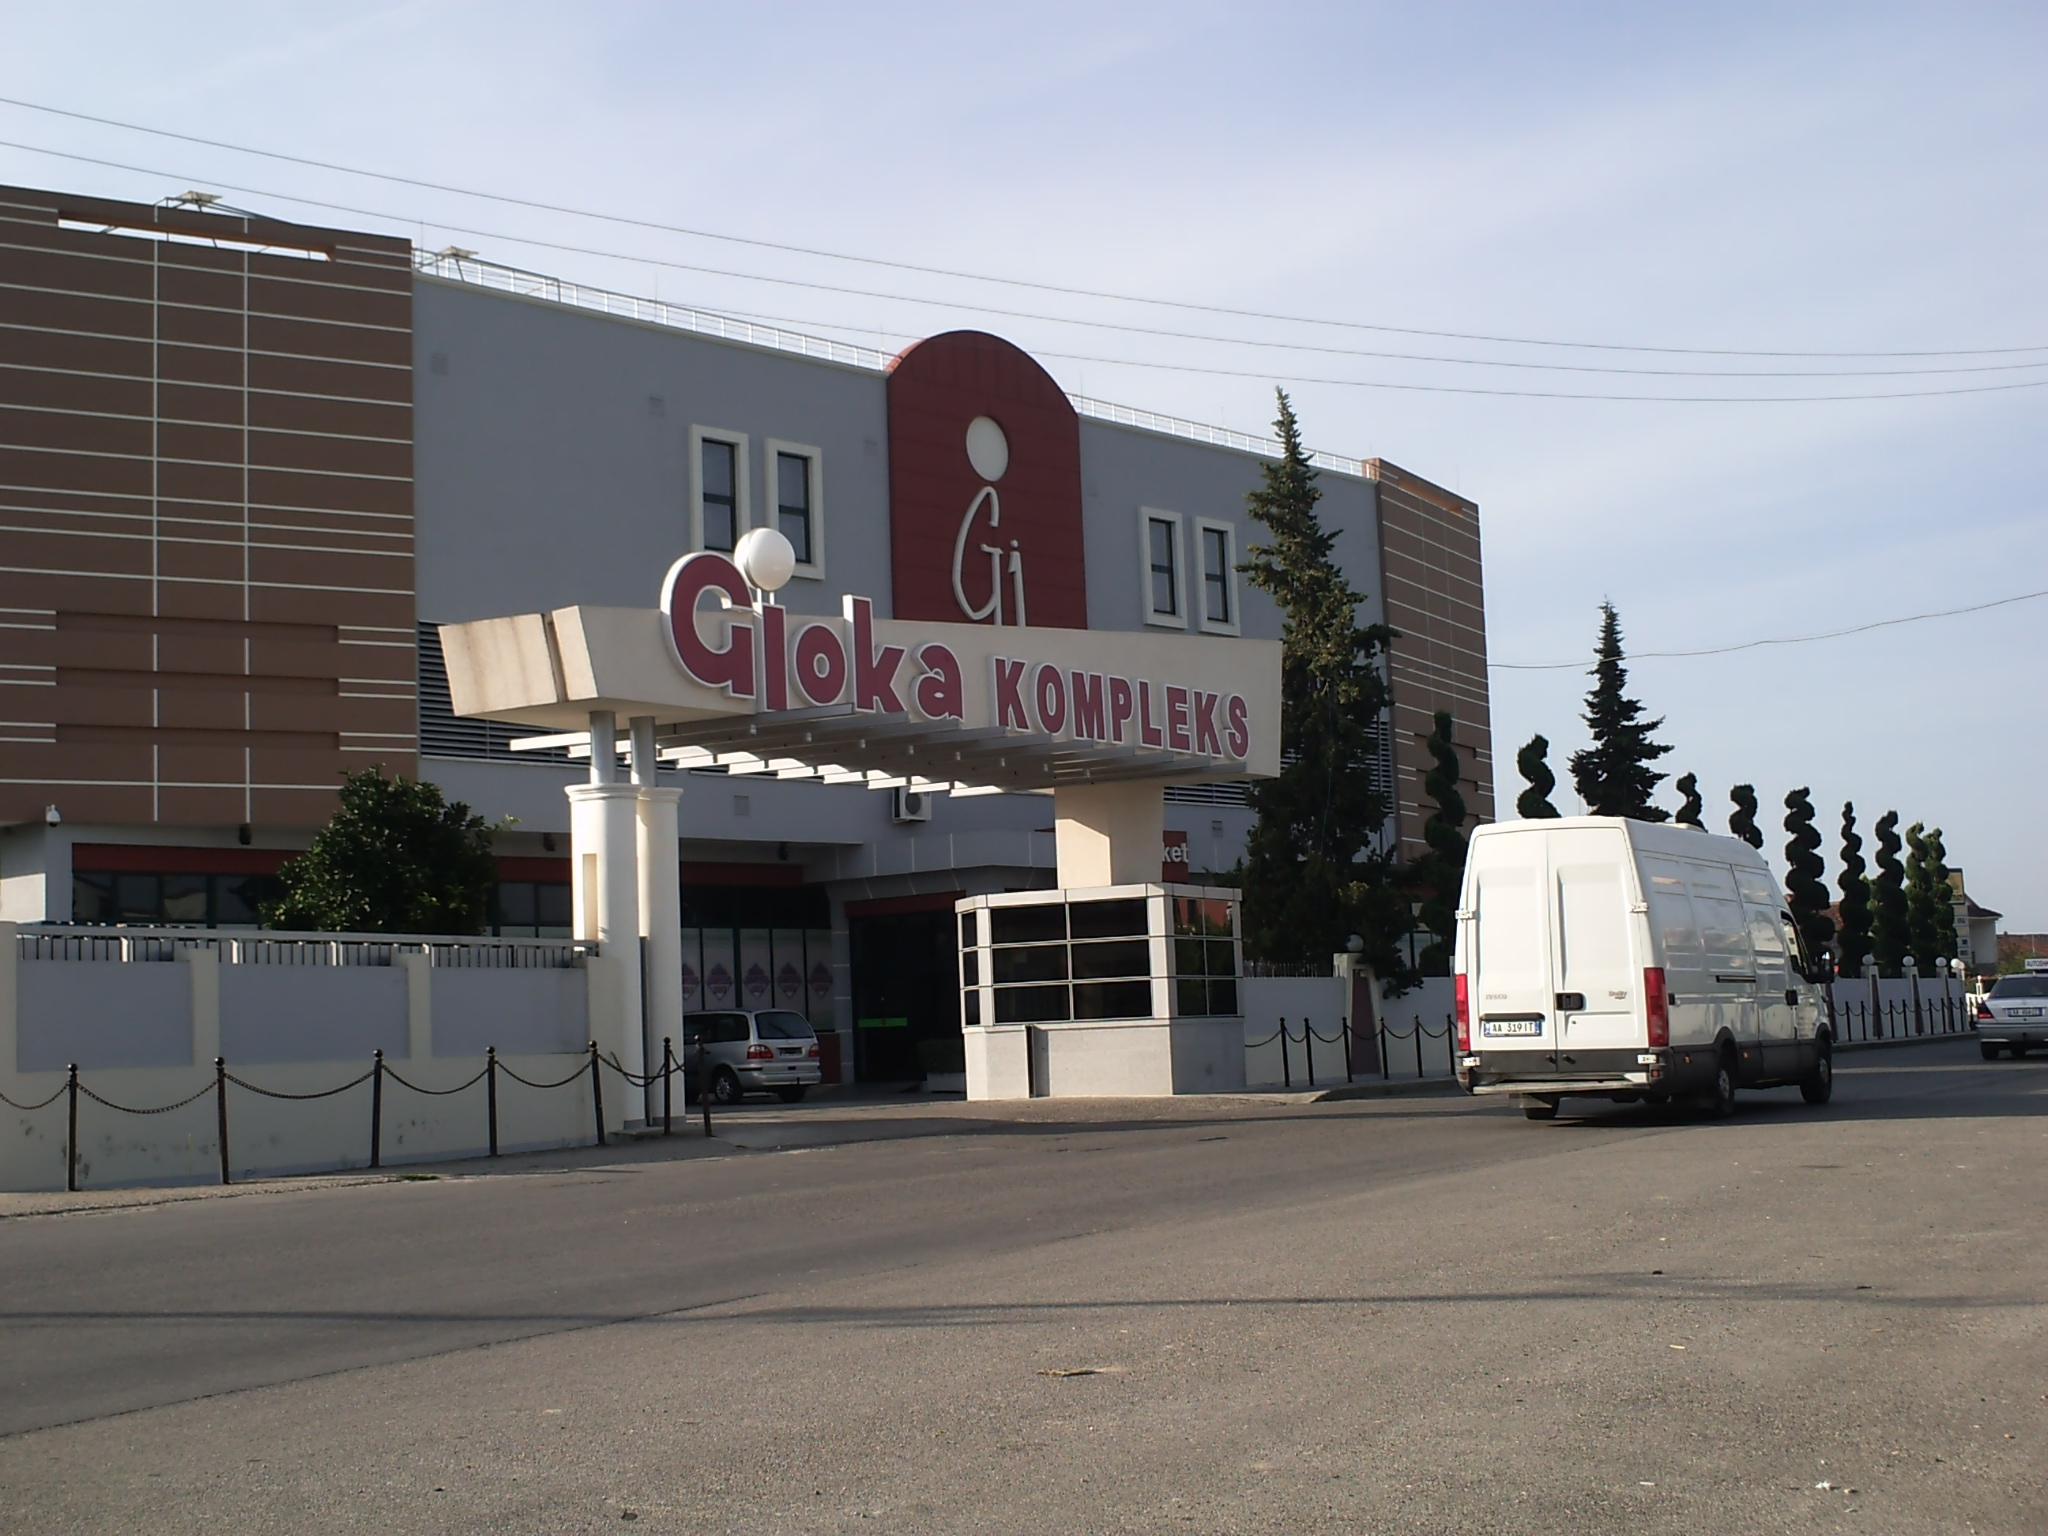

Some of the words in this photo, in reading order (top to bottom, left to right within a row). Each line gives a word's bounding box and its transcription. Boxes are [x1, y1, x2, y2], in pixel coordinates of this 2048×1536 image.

[660, 527, 965, 722] Gioka
[990, 654, 1251, 760] KOMPLEKS
[952, 486, 1027, 627] Gi
